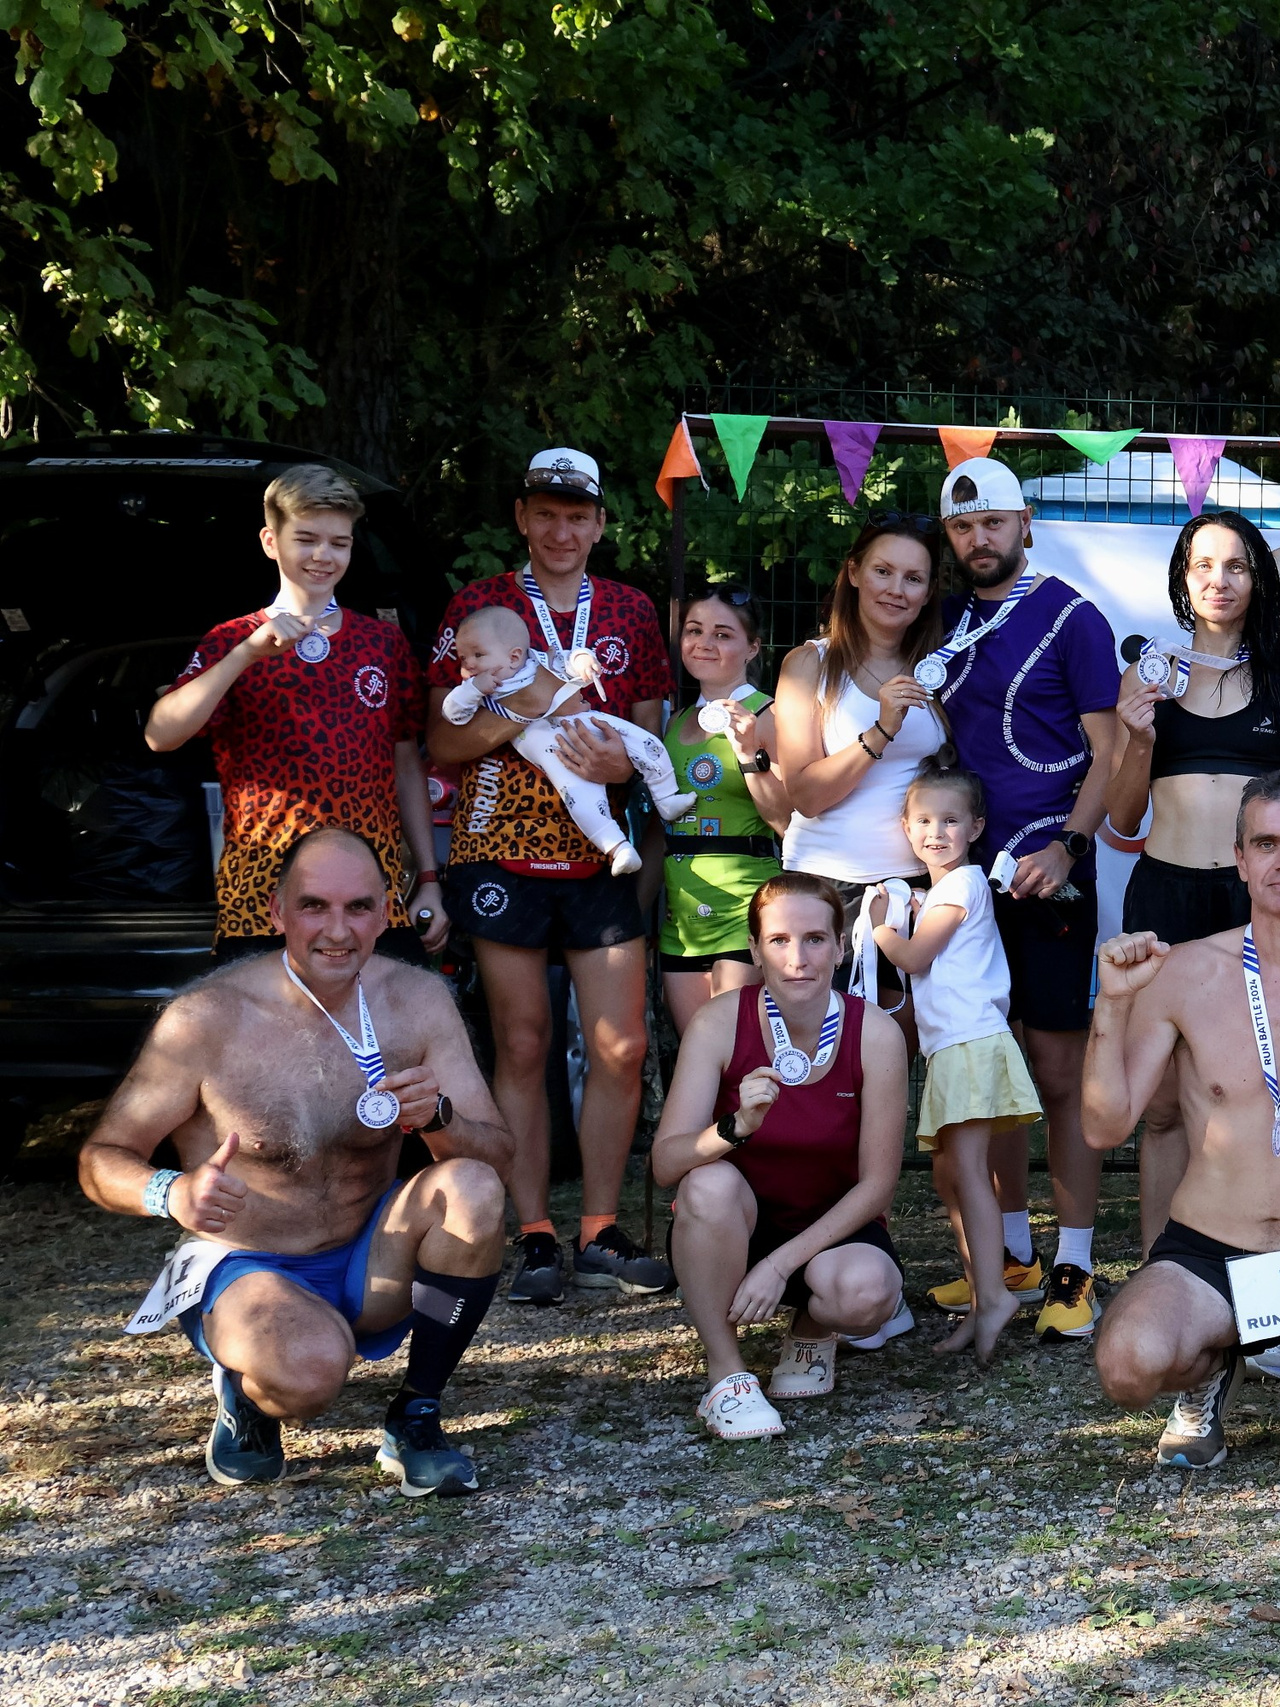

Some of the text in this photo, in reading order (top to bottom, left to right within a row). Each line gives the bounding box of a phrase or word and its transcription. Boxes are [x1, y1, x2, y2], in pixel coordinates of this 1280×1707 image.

[538, 604, 549, 623] 2024
[575, 607, 588, 647] ATTLE 2024
[956, 635, 973, 648] RUN
[1249, 979, 1271, 1065] RUN BATTLE 2024
[367, 1033, 376, 1049] RUN
[164, 1283, 201, 1315] BATTLE
[449, 1297, 466, 1324] KIPSTA
